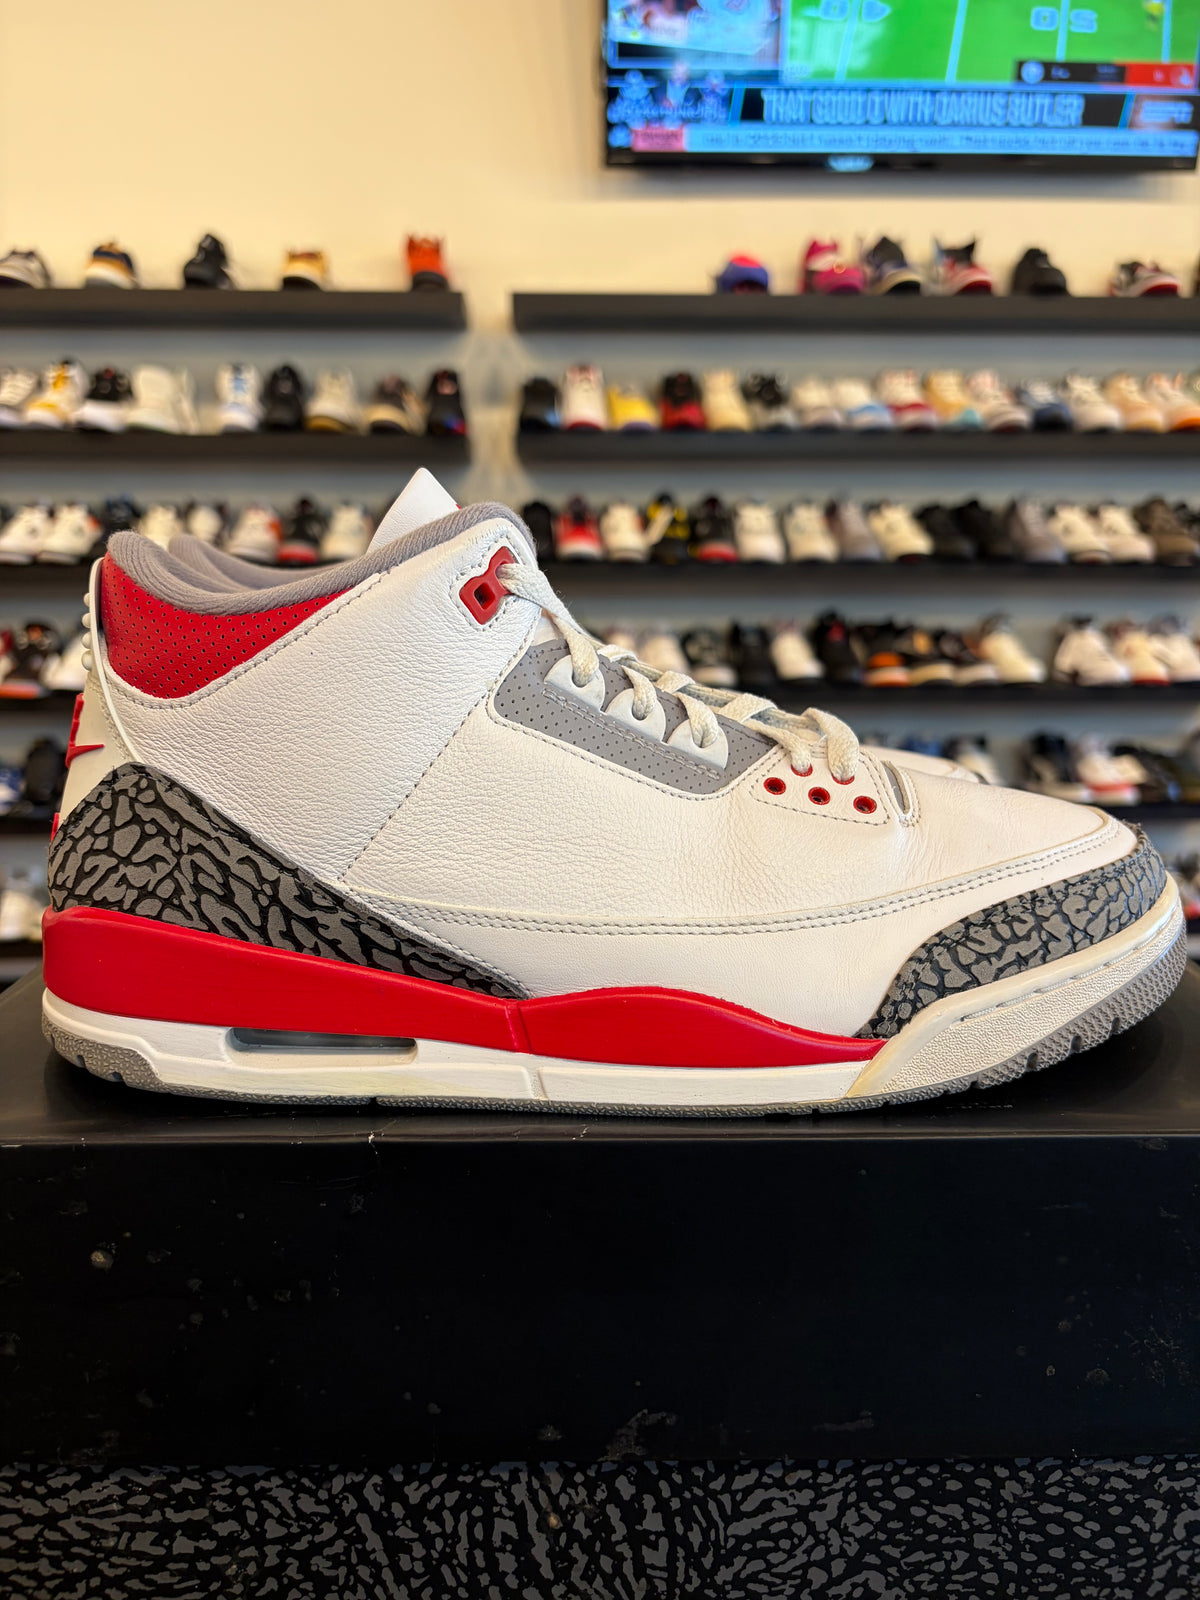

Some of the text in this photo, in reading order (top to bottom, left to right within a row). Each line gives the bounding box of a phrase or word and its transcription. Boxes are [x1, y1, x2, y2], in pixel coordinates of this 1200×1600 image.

[762, 90, 809, 123] THAT
[880, 91, 933, 125] WITH
[1007, 93, 1084, 127] BUTLER
